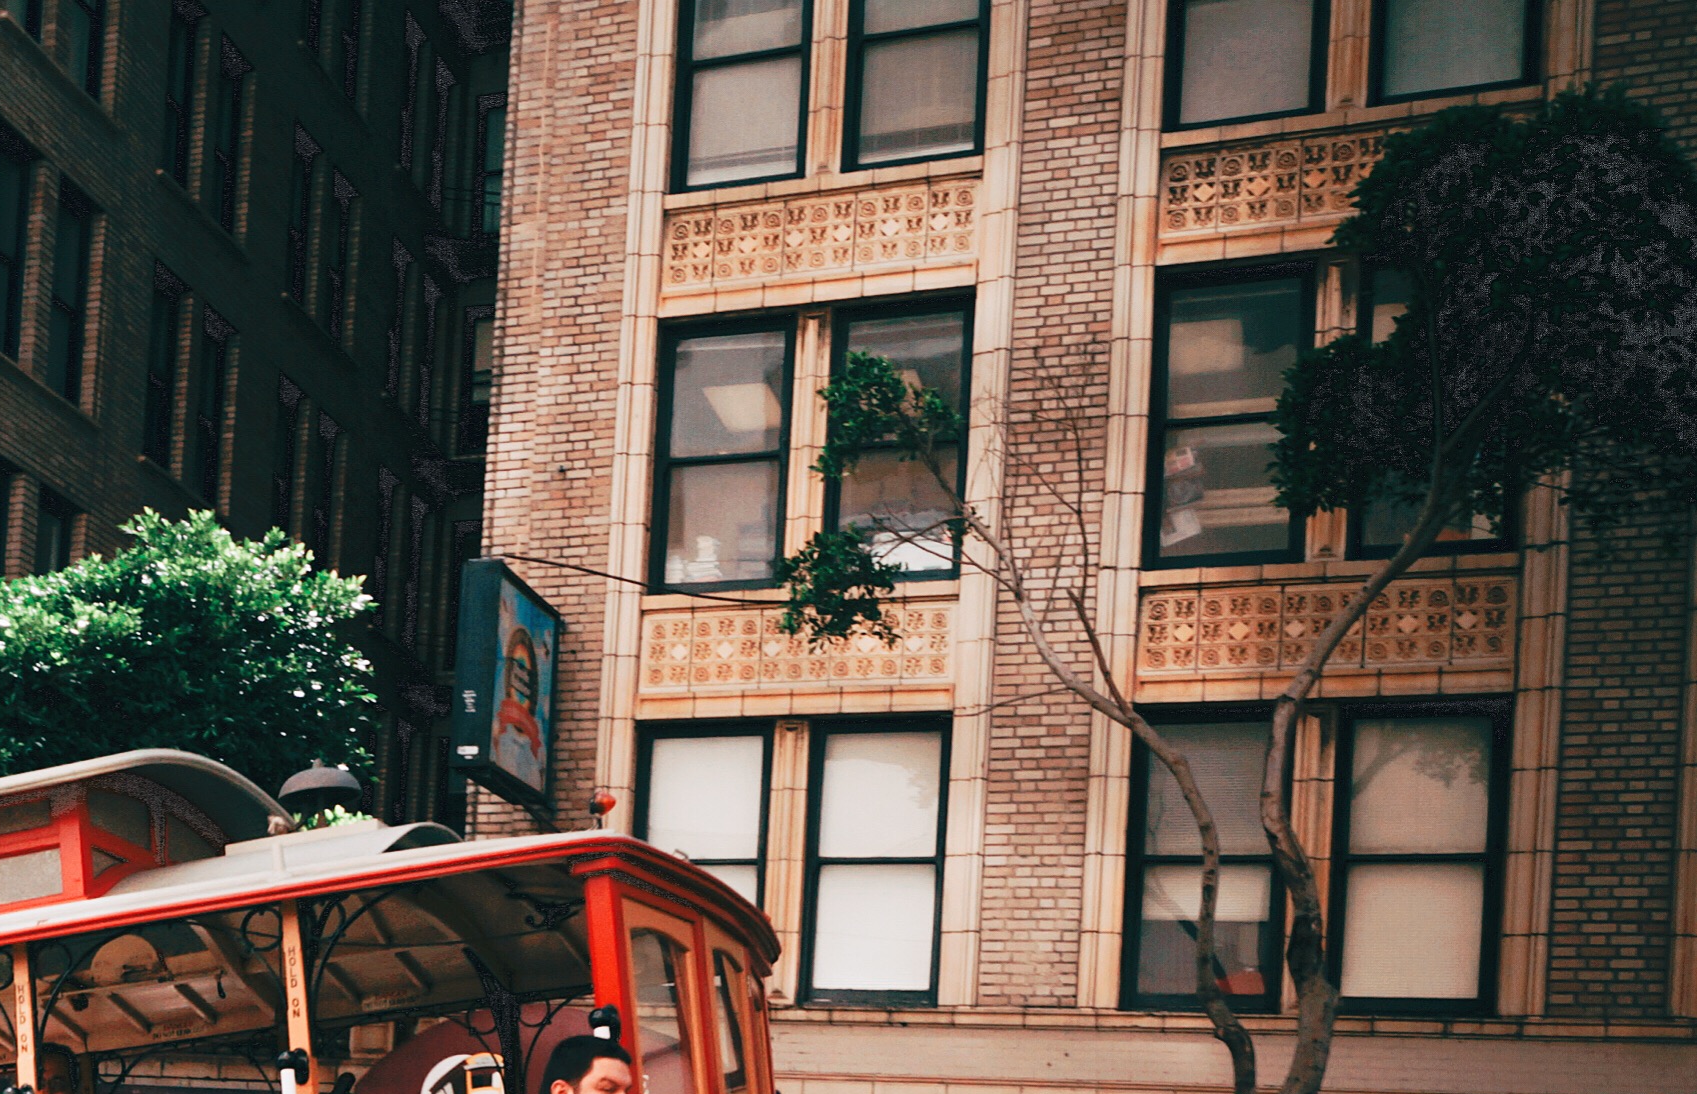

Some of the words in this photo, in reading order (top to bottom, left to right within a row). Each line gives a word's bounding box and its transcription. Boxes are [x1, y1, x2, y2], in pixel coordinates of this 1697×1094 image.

[287, 946, 298, 989] HOLD
[18, 985, 27, 1025] HOLD
[292, 998, 301, 1018] ON
[20, 1034, 29, 1053] ON
